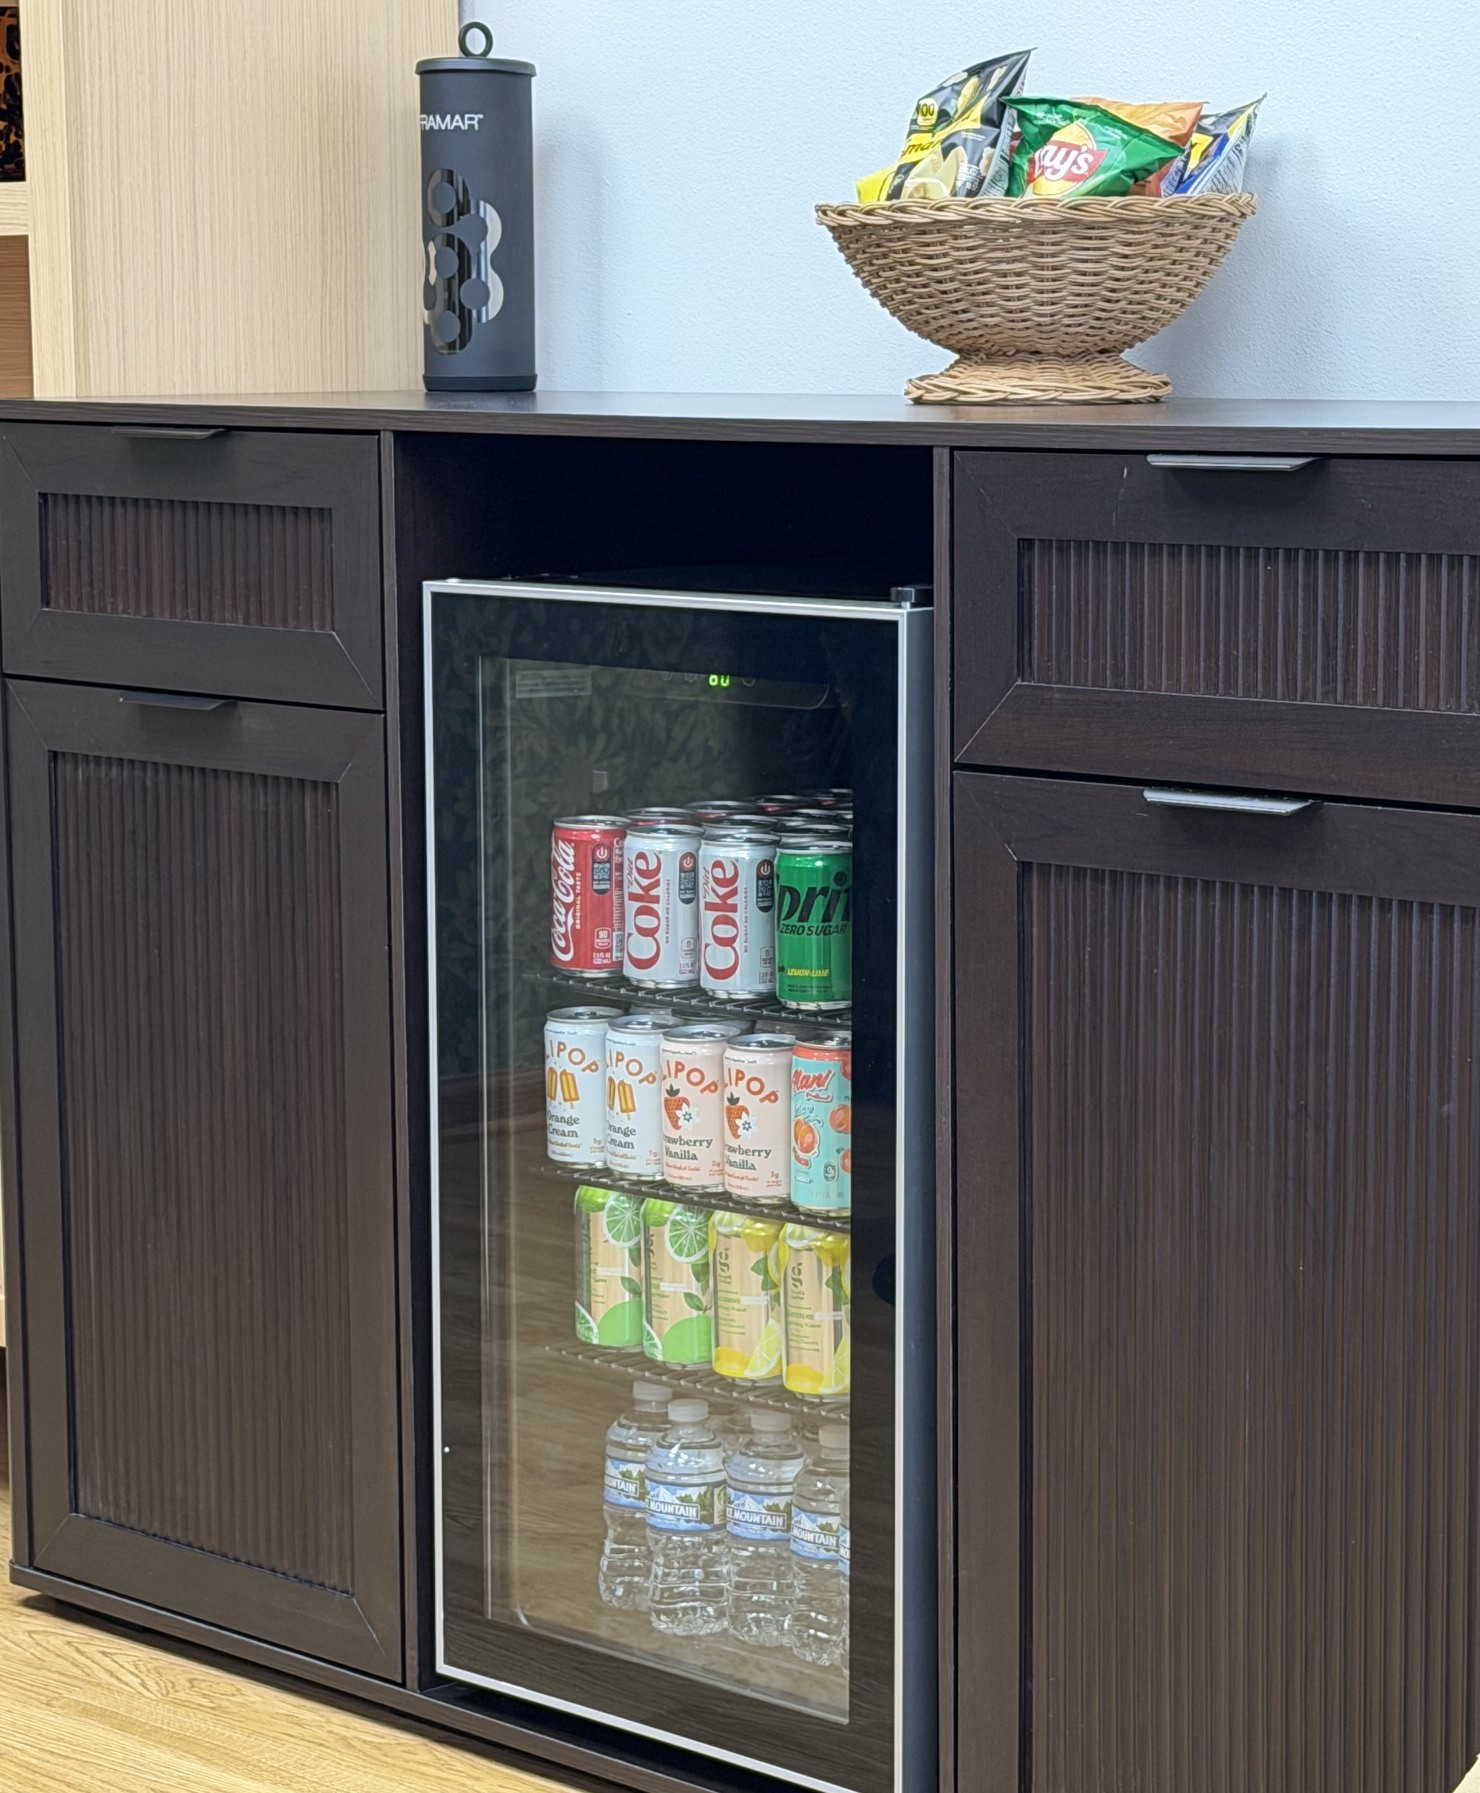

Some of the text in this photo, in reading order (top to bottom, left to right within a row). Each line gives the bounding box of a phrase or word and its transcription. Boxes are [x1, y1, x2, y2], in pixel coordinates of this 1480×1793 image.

[702, 866, 710, 899] Diet
[627, 851, 662, 970] Coke
[777, 871, 851, 932] pri
[704, 859, 740, 981] Coke
[780, 923, 848, 937] ZERO SUGAR
[786, 967, 830, 977] LEMON-LIME
[650, 1499, 697, 1518] MOUNTAIN
[734, 1508, 784, 1527] MOUNTAIN
